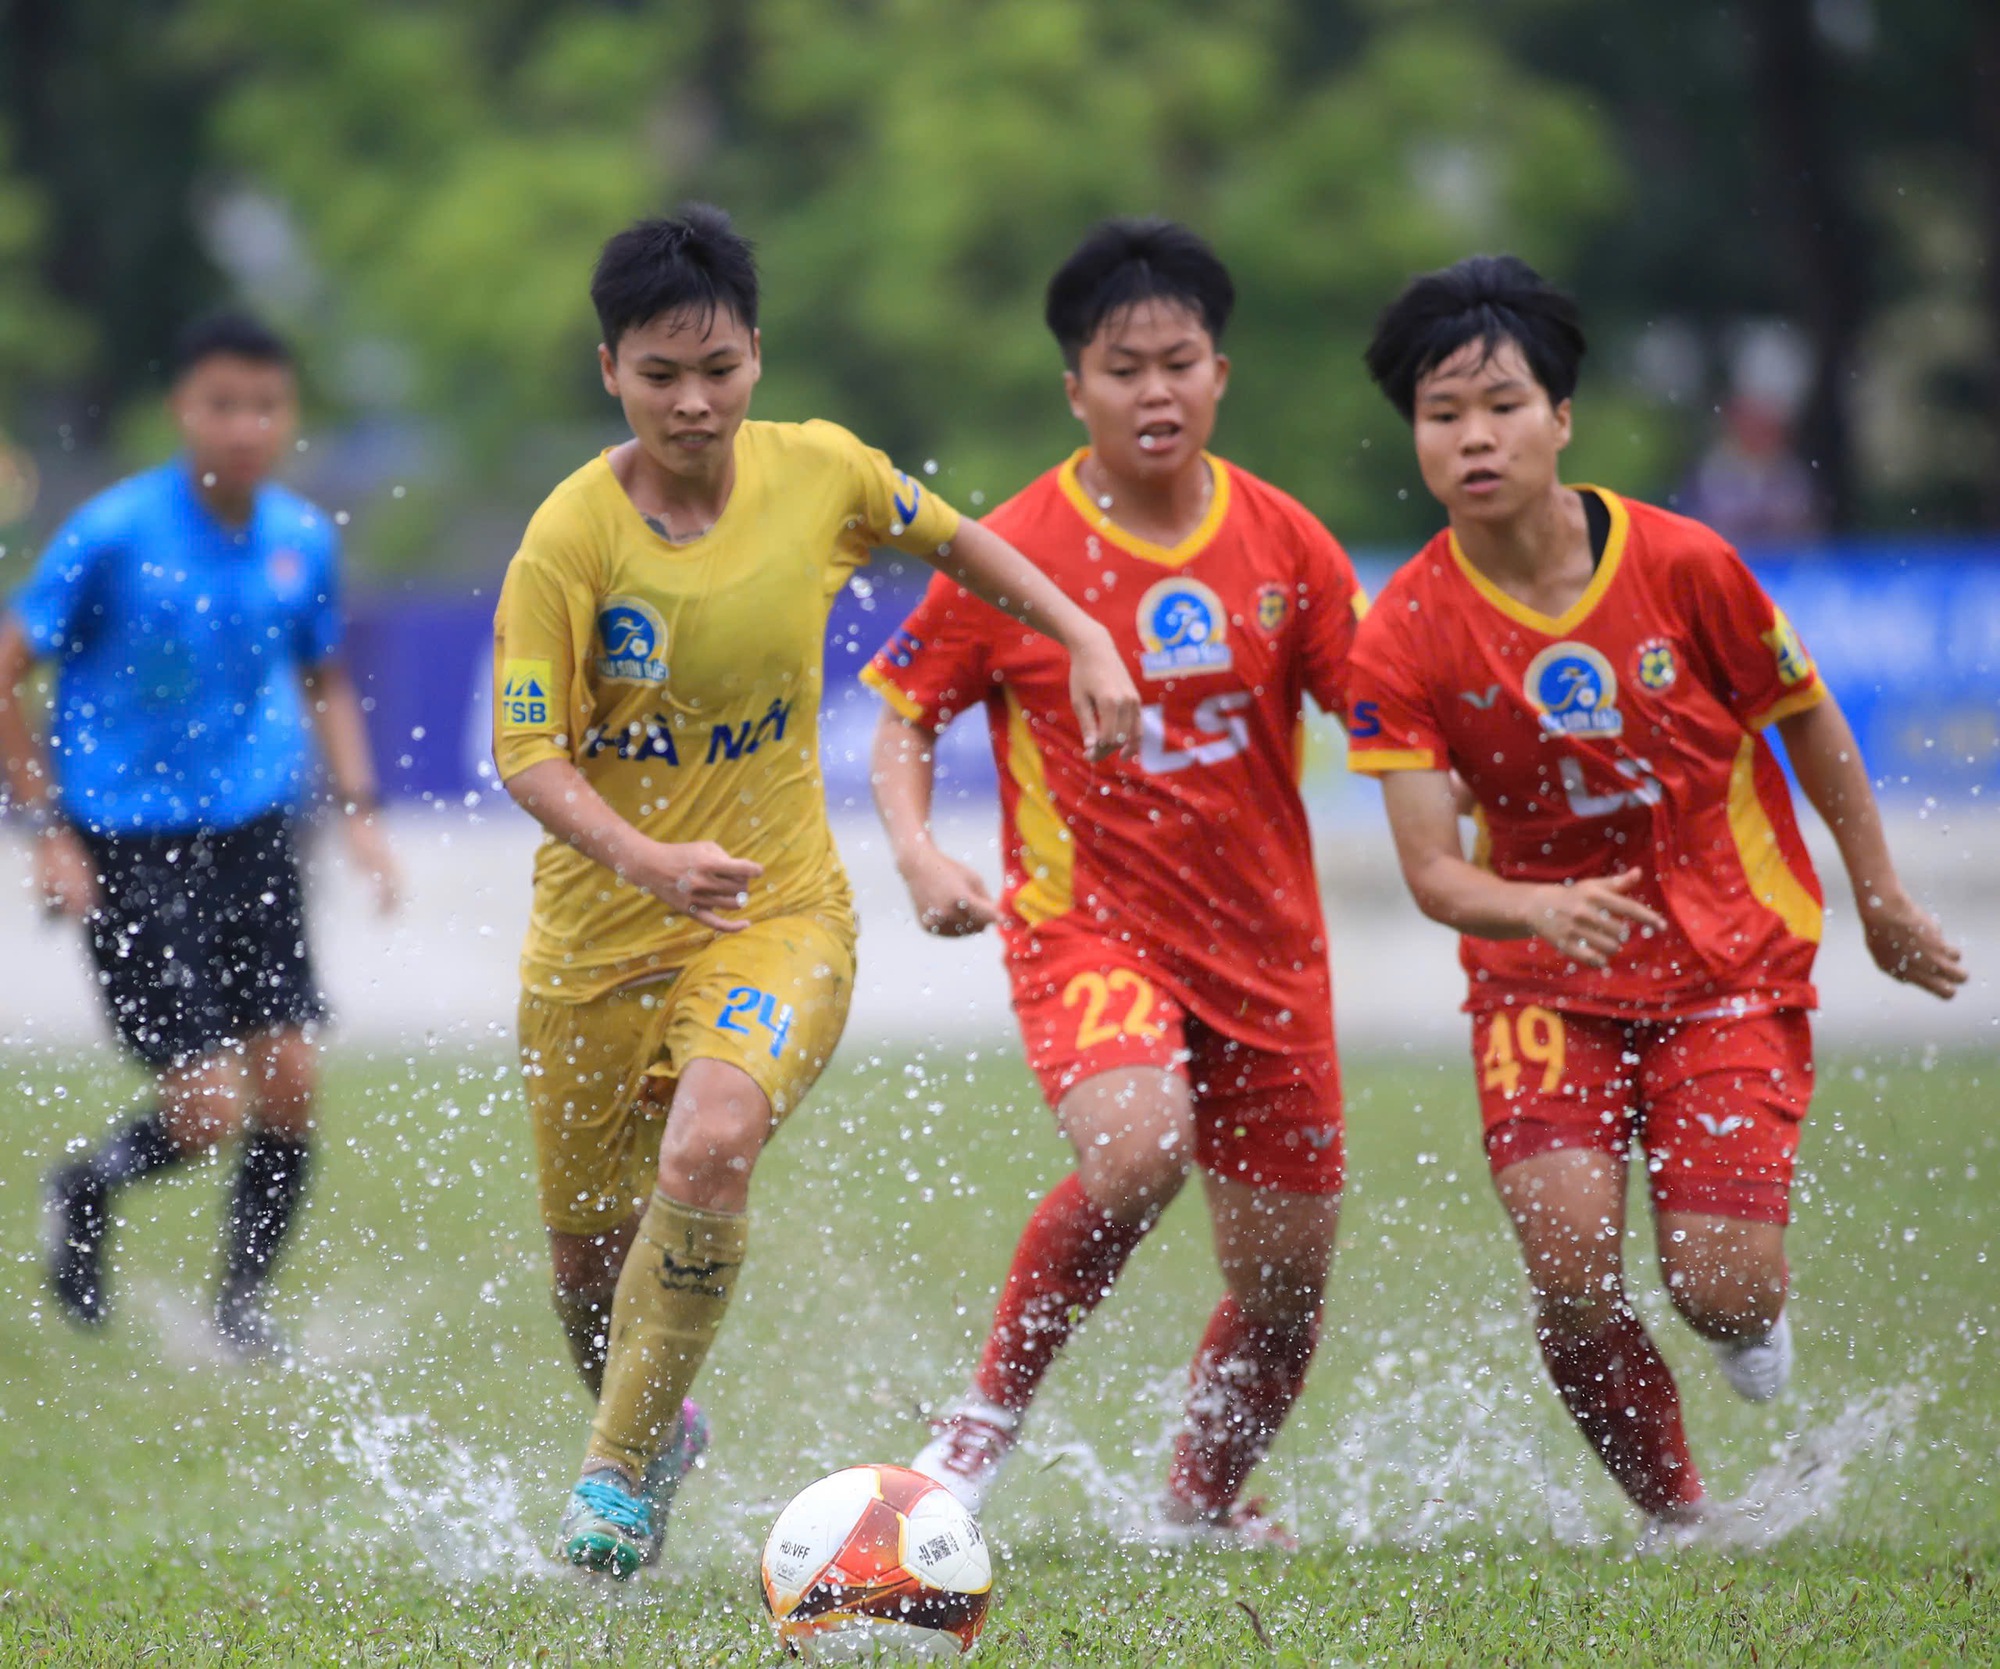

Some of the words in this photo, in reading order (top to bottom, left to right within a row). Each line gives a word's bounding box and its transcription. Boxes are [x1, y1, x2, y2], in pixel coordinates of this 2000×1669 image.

[586, 712, 679, 766] HÀ
[1140, 692, 1250, 774] LS
[715, 986, 794, 1060] 24
[1062, 968, 1164, 1051] 22
[1483, 1004, 1566, 1098] 49
